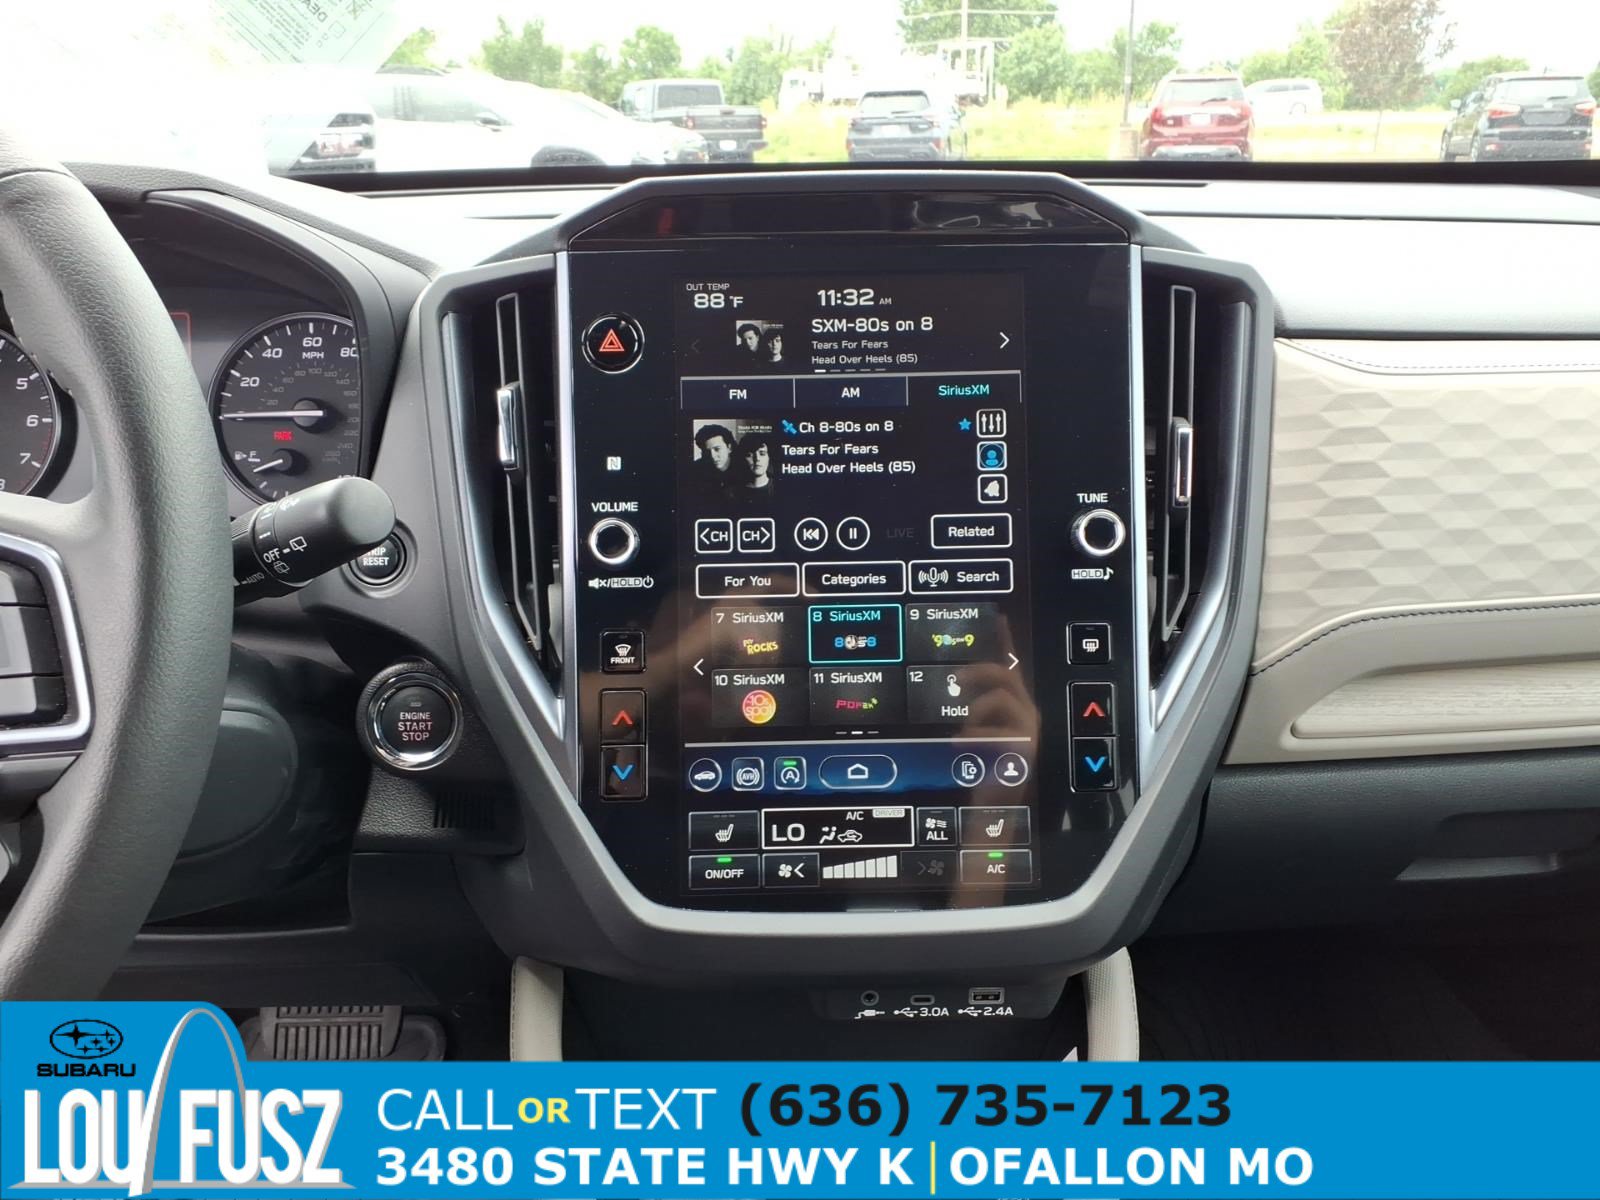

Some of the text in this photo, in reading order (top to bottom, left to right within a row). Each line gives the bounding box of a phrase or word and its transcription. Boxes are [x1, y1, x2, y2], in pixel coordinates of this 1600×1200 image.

[686, 282, 730, 291] OUT TEMP
[693, 293, 725, 309] 88
[817, 288, 892, 306] 11:32 AM
[811, 316, 933, 333] SXM-80s on 8
[302, 337, 322, 347] 60
[811, 339, 889, 350] Tears For Fears
[262, 348, 283, 358] 40
[302, 351, 325, 360] MPH
[811, 353, 918, 365] Head Over Heels (85)
[16, 377, 28, 390] 5
[240, 377, 259, 387] 20
[729, 388, 747, 400] FM
[841, 387, 860, 398] AM
[938, 383, 990, 396] SiriusXM
[26, 414, 39, 427] 6
[799, 420, 894, 433] Ch 8-80s on 8
[250, 450, 257, 458] F
[781, 443, 879, 455] Tears For Fears
[19, 452, 31, 465] 7
[781, 460, 916, 474] Head Over Heels (85)
[1076, 493, 1109, 503] TUNE
[591, 501, 638, 513] VOLUME
[710, 530, 729, 542] CH
[742, 530, 760, 542] CH
[887, 527, 914, 539] LIVE
[948, 525, 995, 538] Related
[263, 548, 281, 563] OFF
[363, 557, 389, 566] RESET
[821, 573, 886, 587] Categories
[956, 570, 1000, 583] Search
[1072, 569, 1103, 579] HOLD
[612, 578, 642, 587] HOLD
[724, 574, 771, 587] For You
[715, 611, 784, 624] 7 SiriusXM
[812, 609, 881, 622] 8 SiriusXM
[909, 607, 979, 620] 9 SiriusXM
[610, 656, 635, 664] FRONT
[715, 673, 785, 686] 10 SiriusXM
[813, 671, 882, 684] 11 SiriusXM
[909, 671, 923, 682] 12
[400, 711, 431, 720] ENGINE
[941, 705, 968, 717] Hold
[398, 721, 432, 731] START
[402, 732, 429, 741] STOP
[846, 811, 864, 820] A/C
[875, 808, 903, 816] DRIVER
[772, 823, 805, 842] LO
[926, 831, 948, 841] ALL
[705, 869, 744, 879] ON/OFF
[987, 864, 1006, 874] A/C
[919, 1007, 949, 1017] 3.0A
[983, 1006, 1014, 1016] 2.4A
